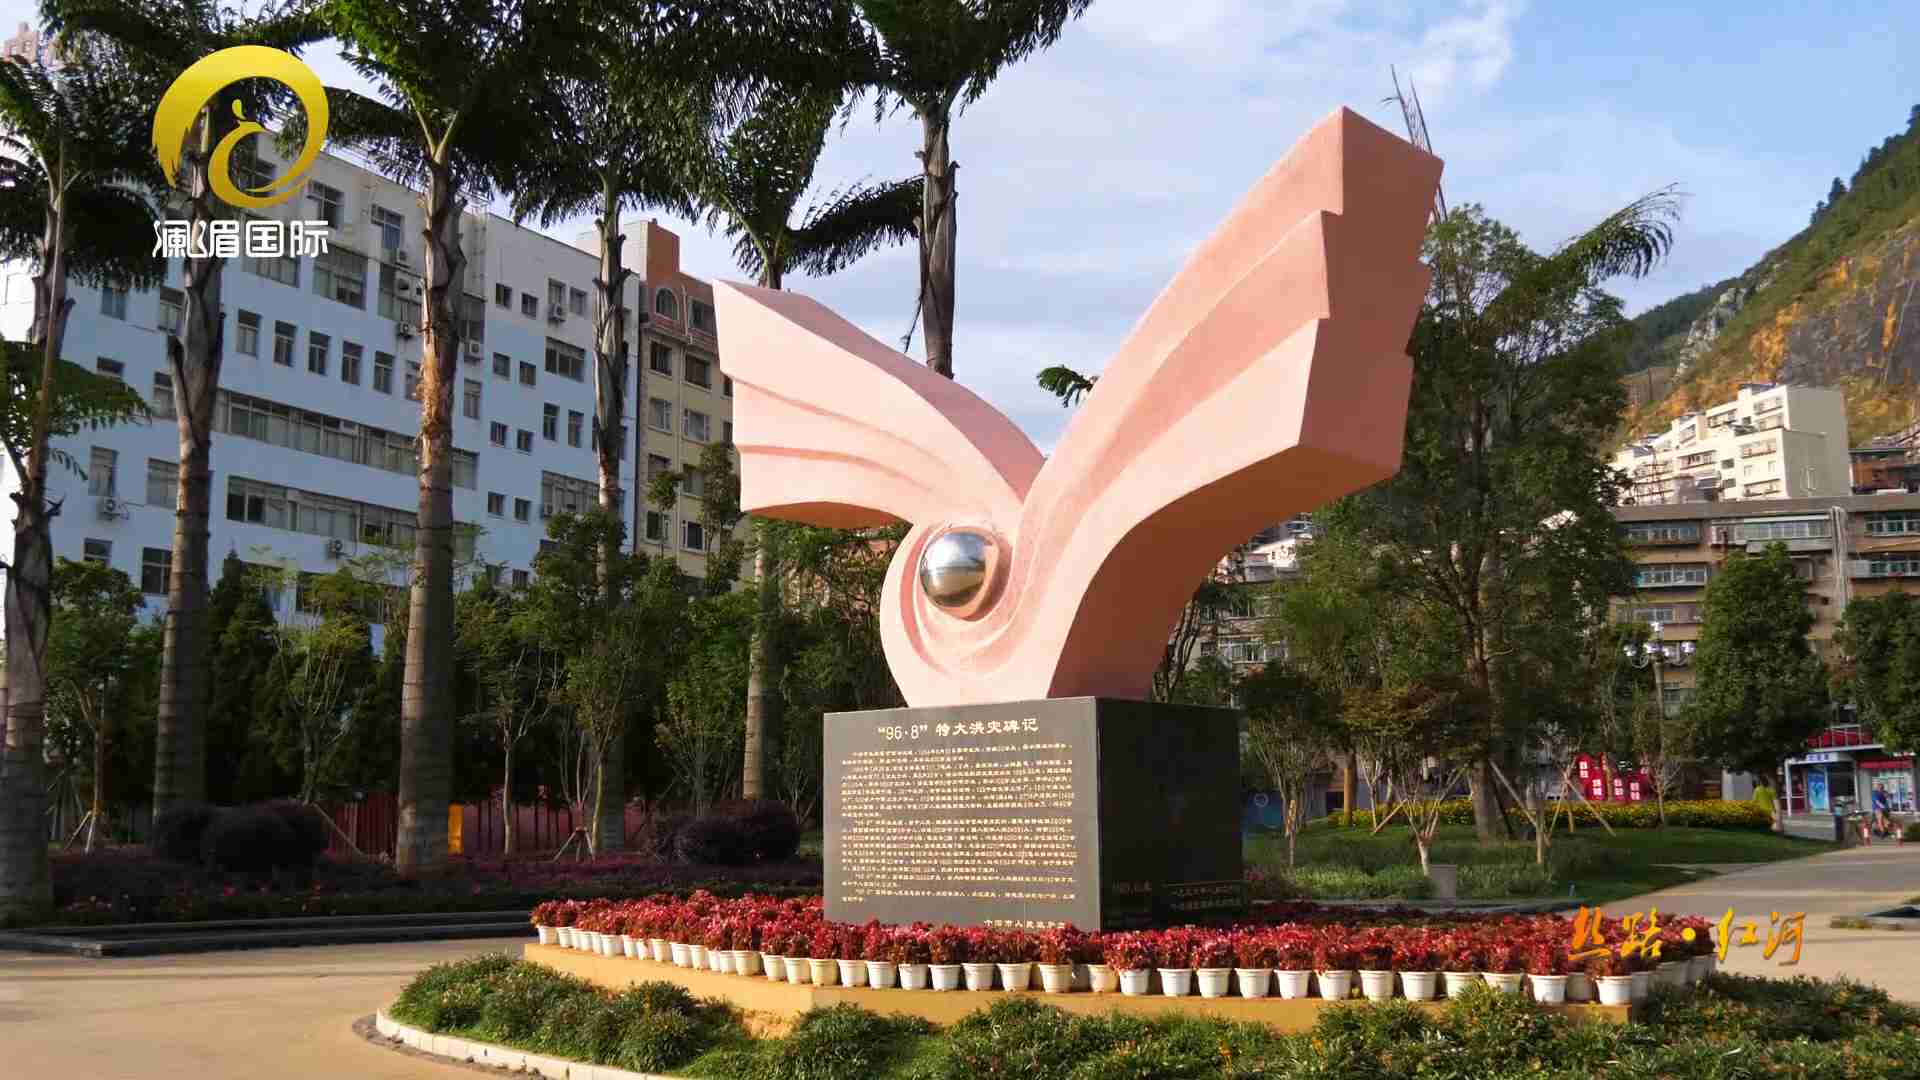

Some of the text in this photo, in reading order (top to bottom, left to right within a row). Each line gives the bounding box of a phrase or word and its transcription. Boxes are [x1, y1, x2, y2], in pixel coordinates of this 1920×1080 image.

[935, 718, 1039, 736] 特大洪灾碑记
